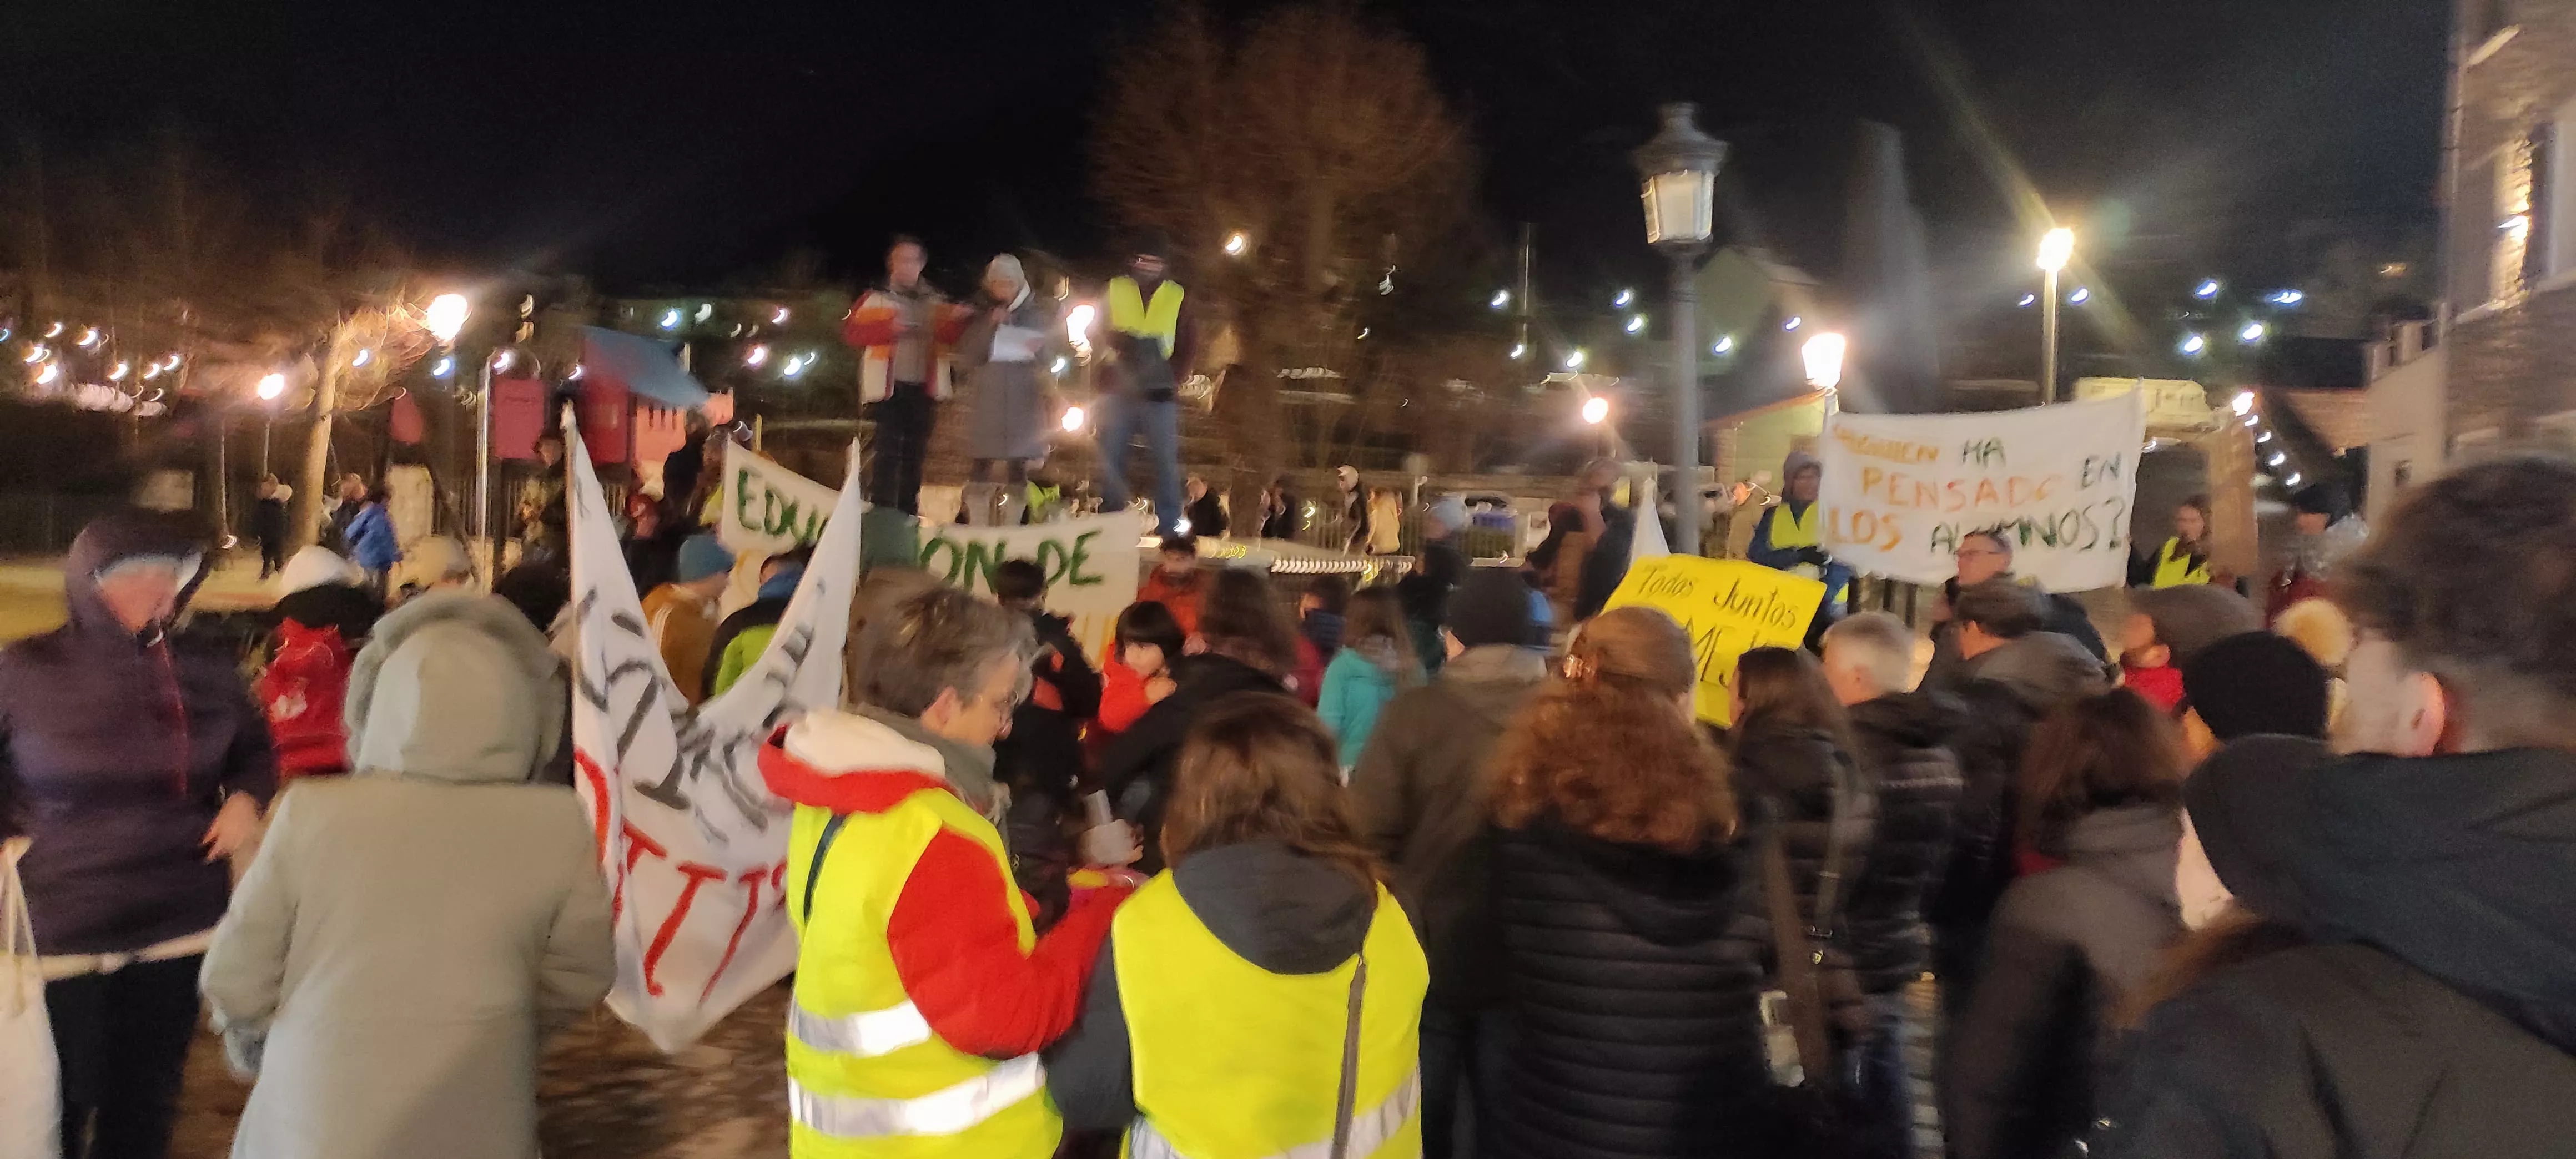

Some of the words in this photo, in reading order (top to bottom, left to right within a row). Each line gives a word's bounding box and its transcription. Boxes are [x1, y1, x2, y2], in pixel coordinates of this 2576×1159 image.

[1961, 437, 2007, 468] HA
[2081, 452, 2121, 489] EN
[1828, 507, 1904, 553] LOS
[1036, 526, 1104, 586] DE
[1637, 563, 1696, 599] Todos
[1713, 575, 1798, 632] Juntos
